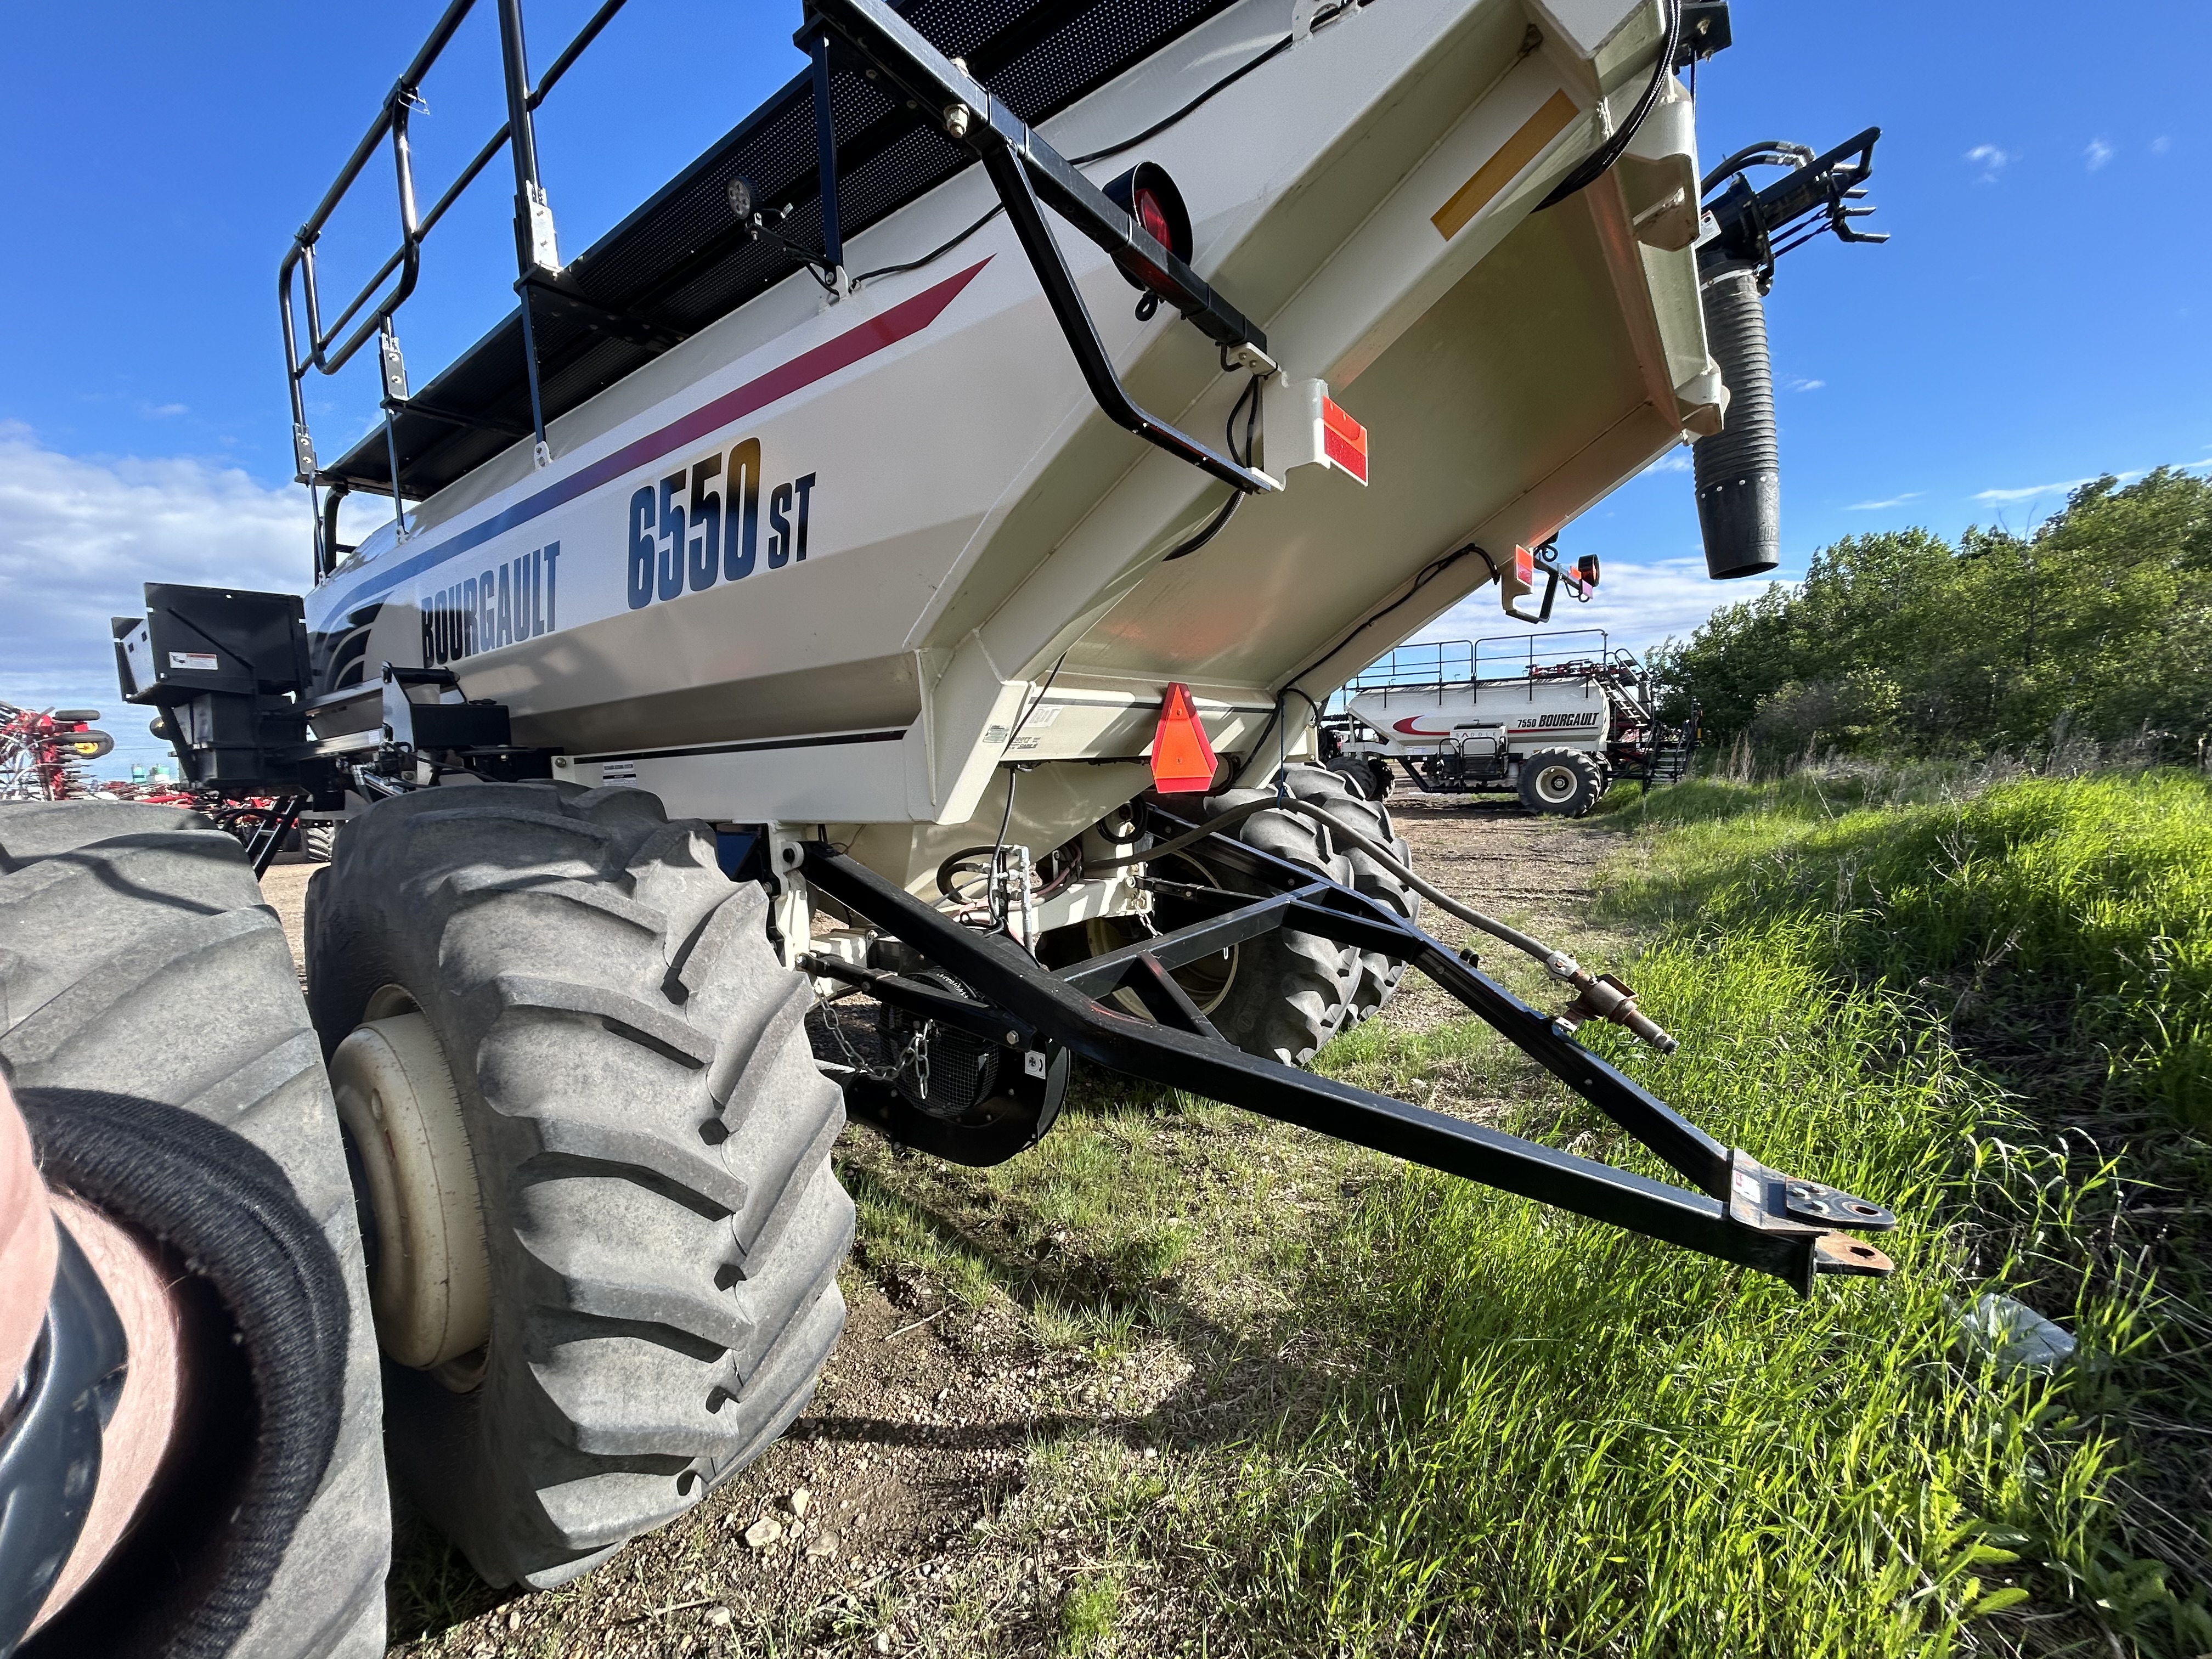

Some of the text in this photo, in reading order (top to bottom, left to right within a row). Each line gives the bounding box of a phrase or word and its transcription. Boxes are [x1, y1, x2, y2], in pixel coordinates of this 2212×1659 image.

[628, 437, 816, 610] 6550 ST
[421, 540, 561, 669] BOURGAULT
[1517, 712, 1599, 727] 7550 BOURGAULT
